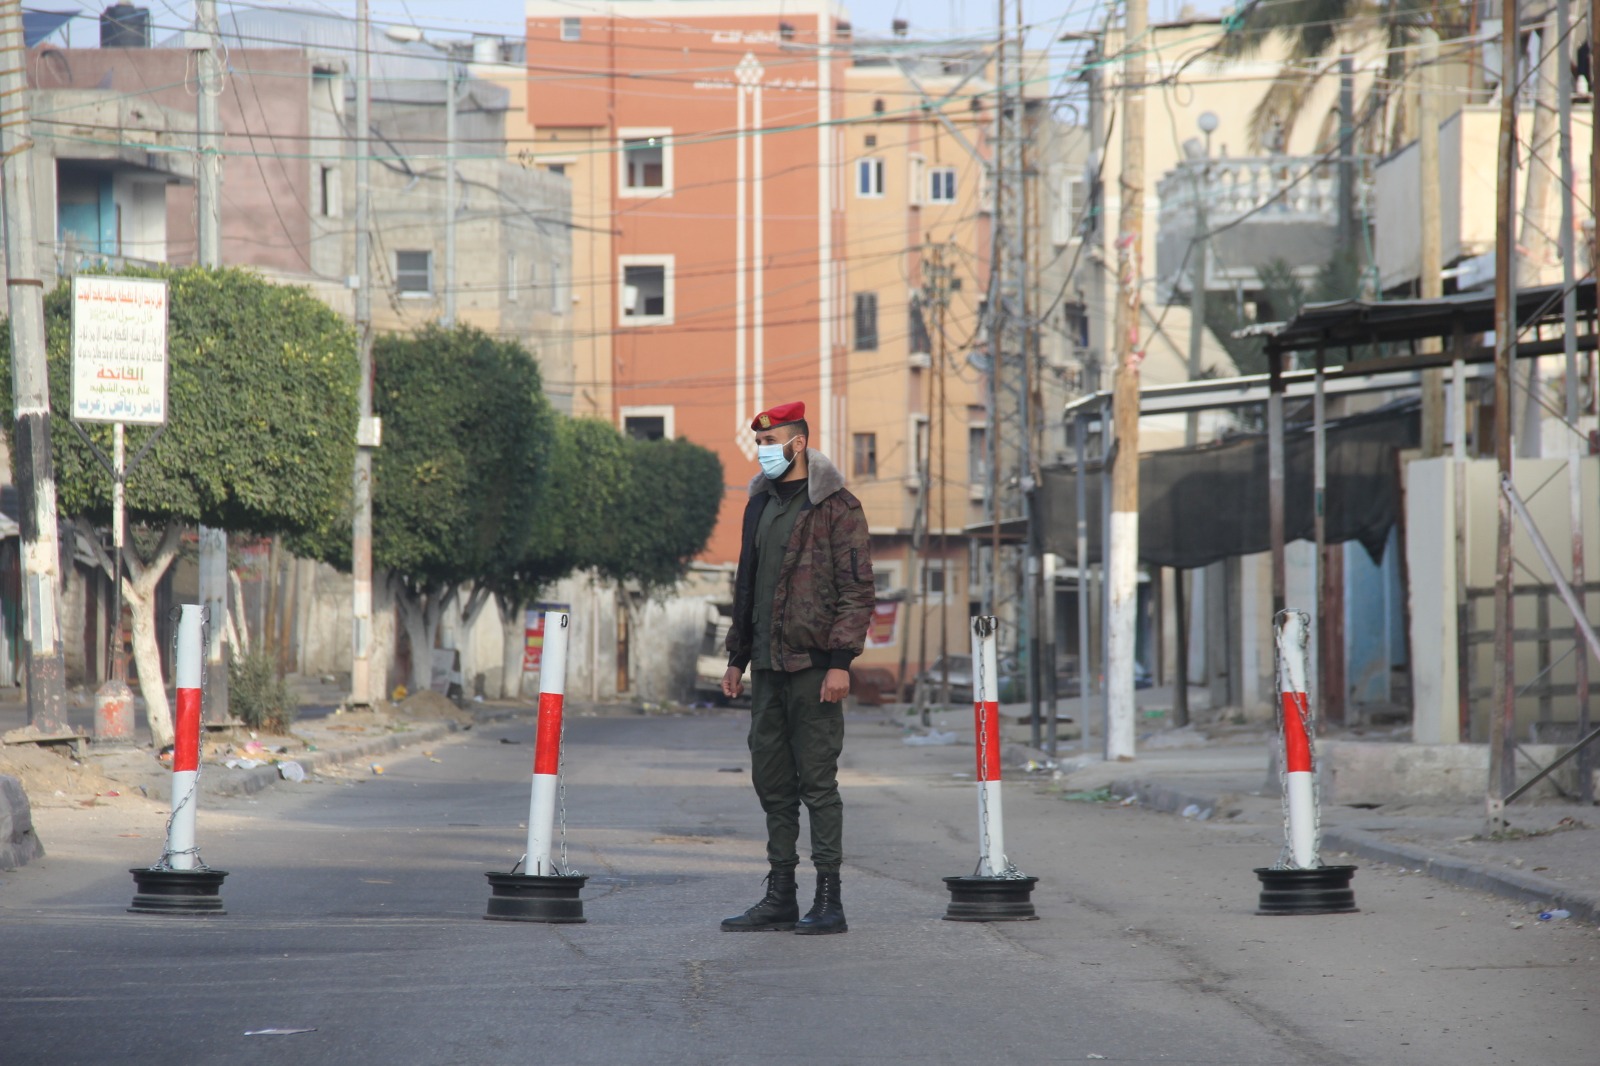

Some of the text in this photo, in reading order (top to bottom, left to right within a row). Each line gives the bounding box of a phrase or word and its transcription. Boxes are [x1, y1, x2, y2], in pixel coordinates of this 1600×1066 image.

[97, 363, 143, 381] الفاتحة
[90, 383, 118, 394] الشهيد
[119, 384, 134, 397] روح
[109, 397, 137, 417] رياض
